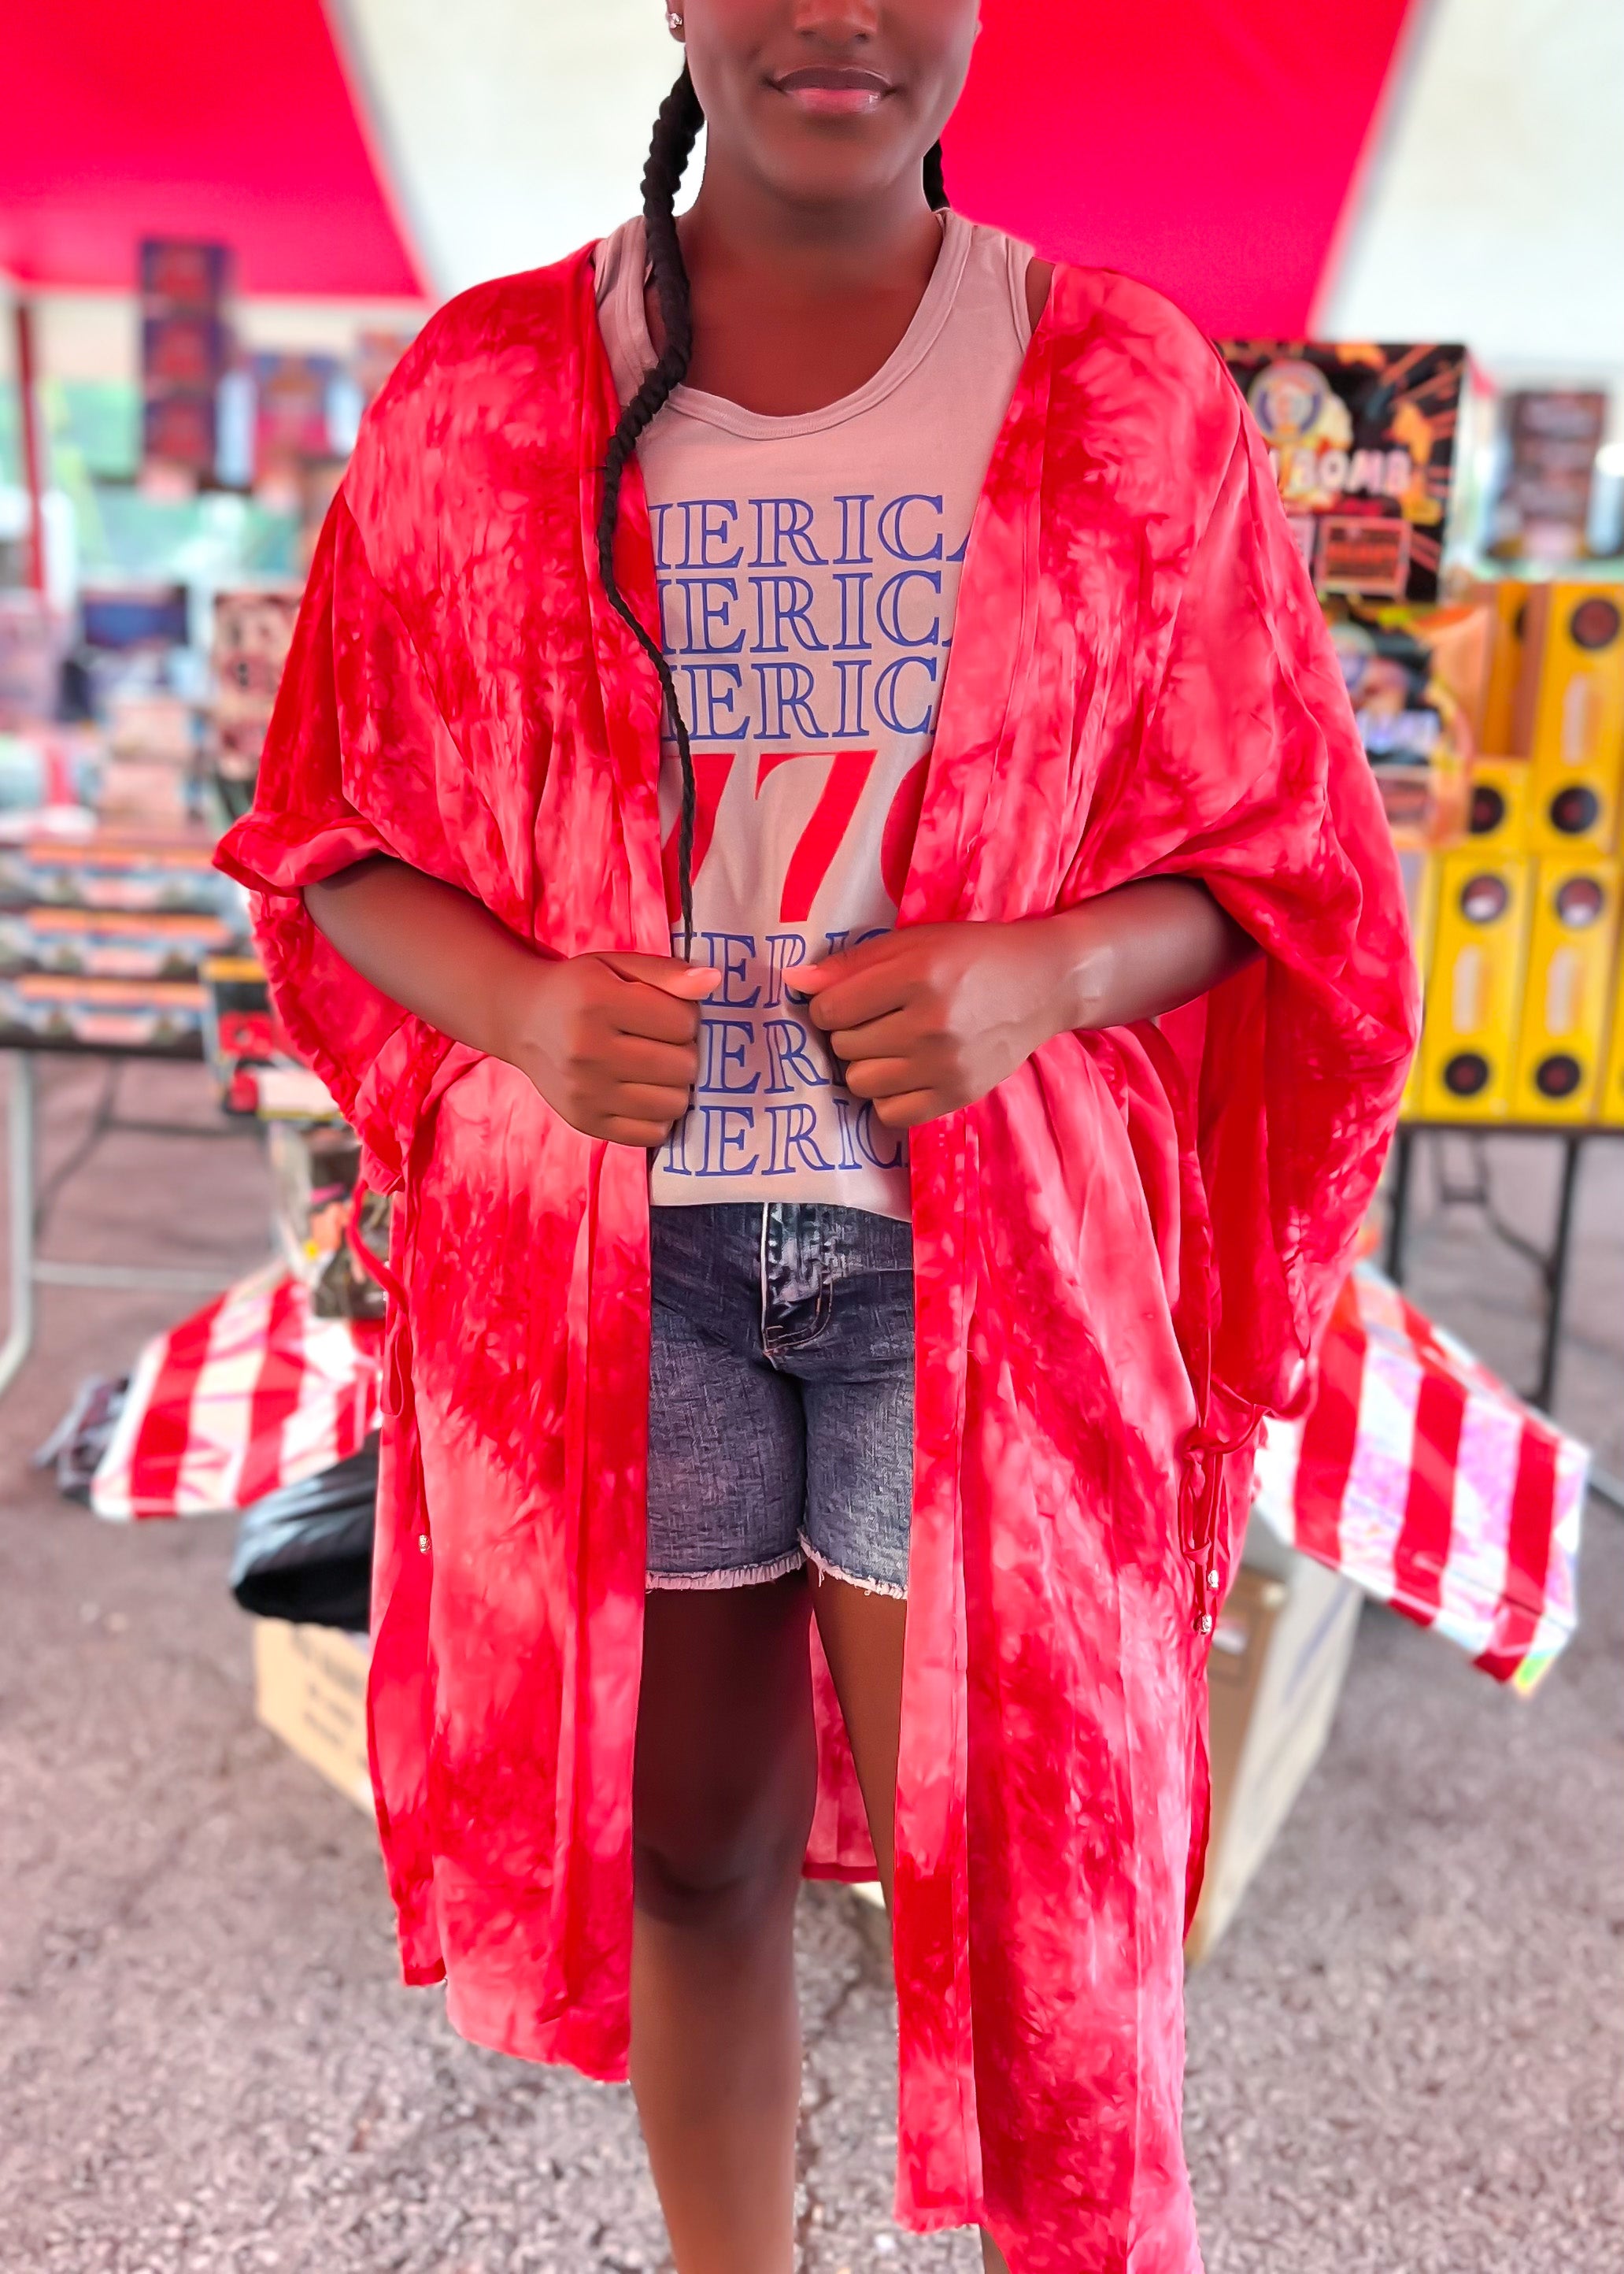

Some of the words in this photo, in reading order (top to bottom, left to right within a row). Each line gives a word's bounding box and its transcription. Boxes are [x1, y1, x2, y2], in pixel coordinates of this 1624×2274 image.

[649, 494, 970, 569] ERIC
[656, 570, 952, 654] ERIC
[662, 656, 936, 740] ERIC
[664, 1098, 908, 1176] ERIC
